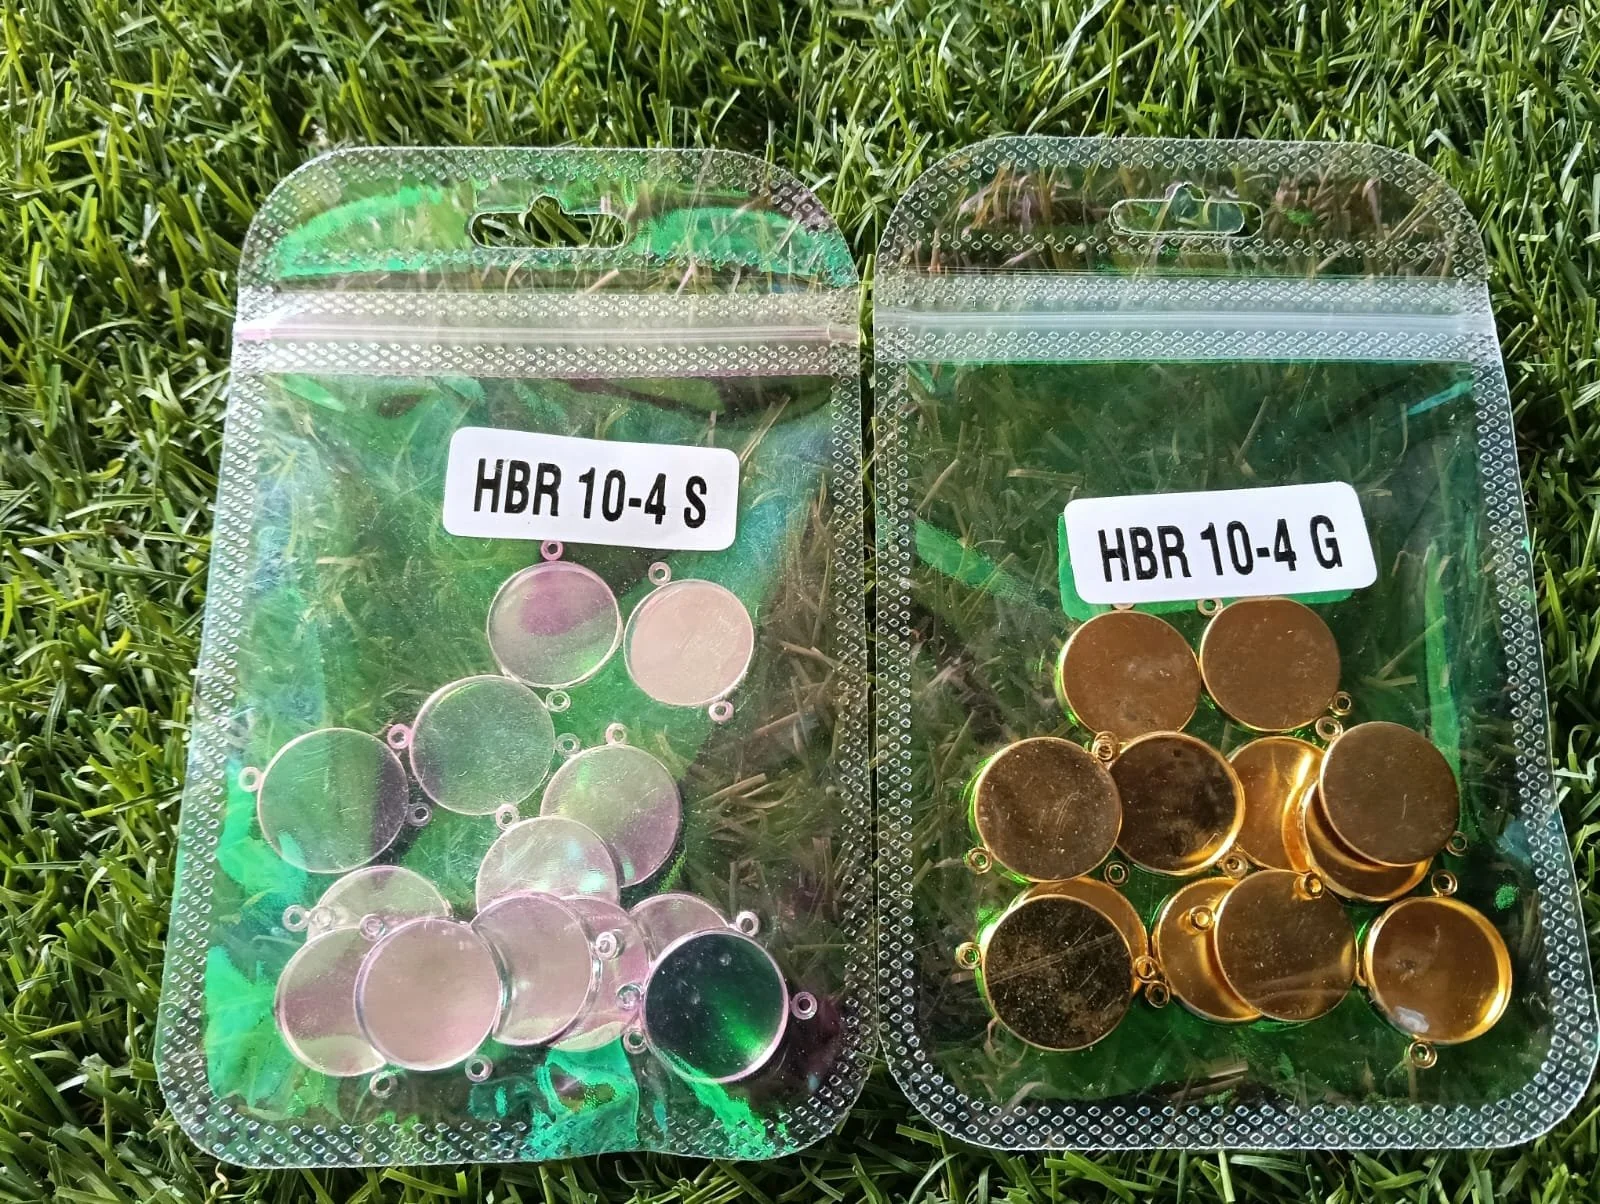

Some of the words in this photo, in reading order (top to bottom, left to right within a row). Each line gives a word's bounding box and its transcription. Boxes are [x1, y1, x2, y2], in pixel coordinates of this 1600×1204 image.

[473, 458, 562, 517] HBR
[578, 466, 667, 525] 10-4
[683, 475, 708, 529] S
[1097, 526, 1193, 583] HBR
[1199, 518, 1297, 576] 10-4
[1309, 514, 1343, 570] G
